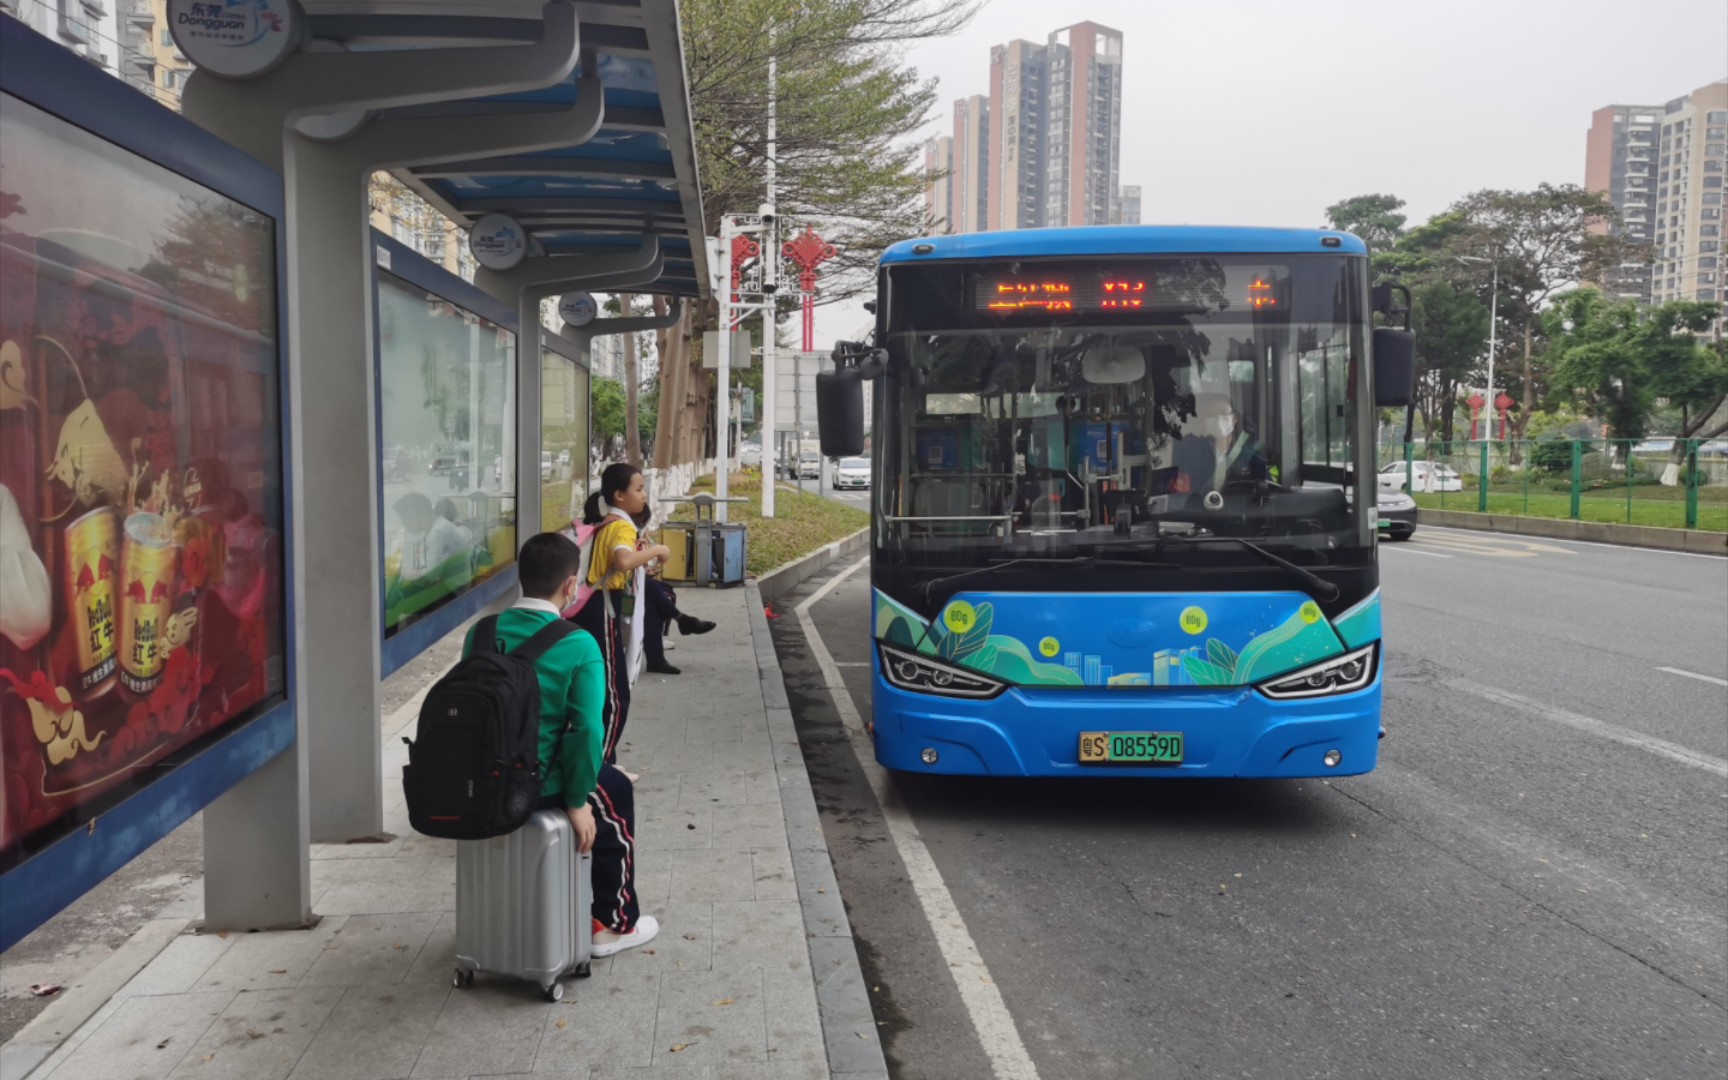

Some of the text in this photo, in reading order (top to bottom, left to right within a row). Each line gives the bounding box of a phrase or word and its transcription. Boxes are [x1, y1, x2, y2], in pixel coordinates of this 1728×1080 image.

[178, 12, 246, 30] Dongguan
[950, 610, 968, 625] 80g
[1186, 614, 1201, 628] 80g
[90, 619, 114, 653] 红牛
[132, 641, 158, 666] 红牛
